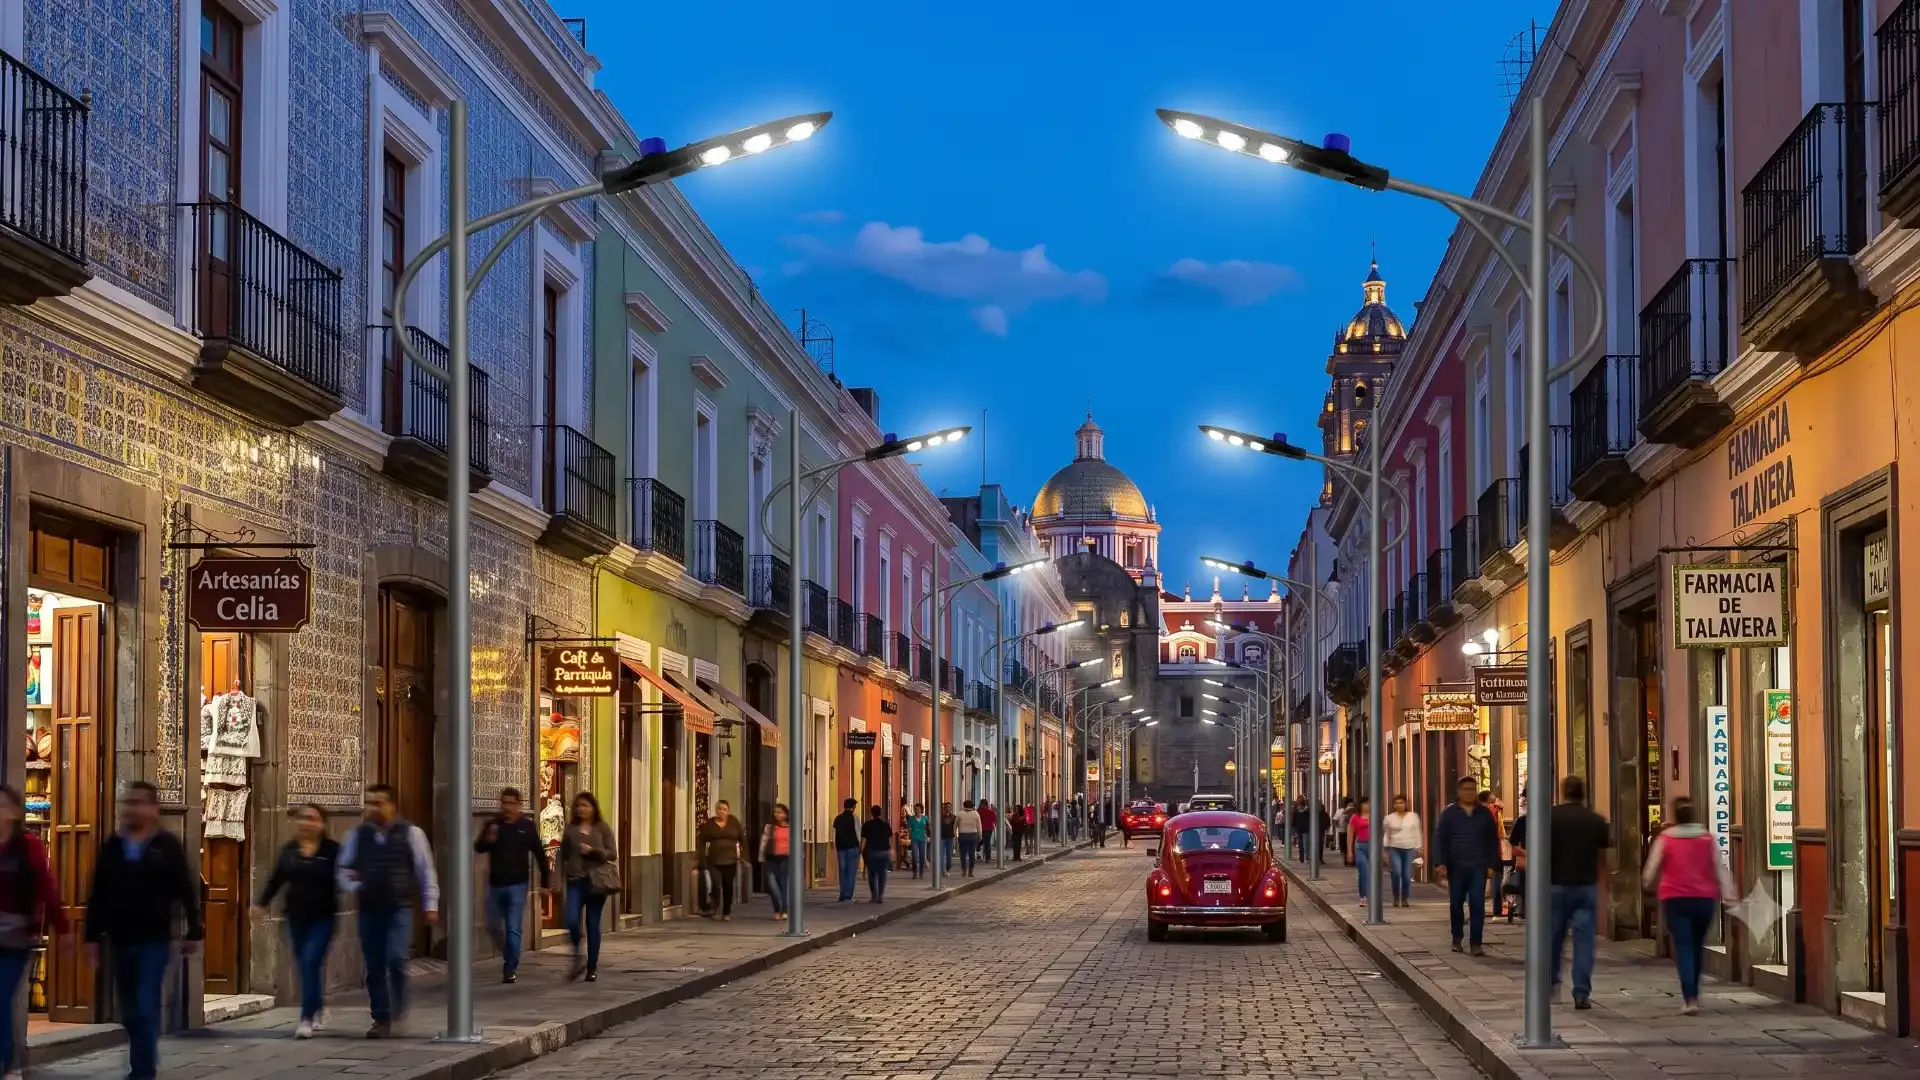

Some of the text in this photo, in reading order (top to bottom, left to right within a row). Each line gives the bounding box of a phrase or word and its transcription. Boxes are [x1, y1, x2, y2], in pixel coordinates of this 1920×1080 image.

[1728, 400, 1790, 480] FARMACIA
[1730, 454, 1796, 528] TALAVERA
[198, 567, 300, 590] Artesanías
[1684, 572, 1776, 594] FARMACIA
[216, 595, 279, 621] Celia
[1718, 597, 1742, 614] DE
[1685, 616, 1777, 639] TALAVERA
